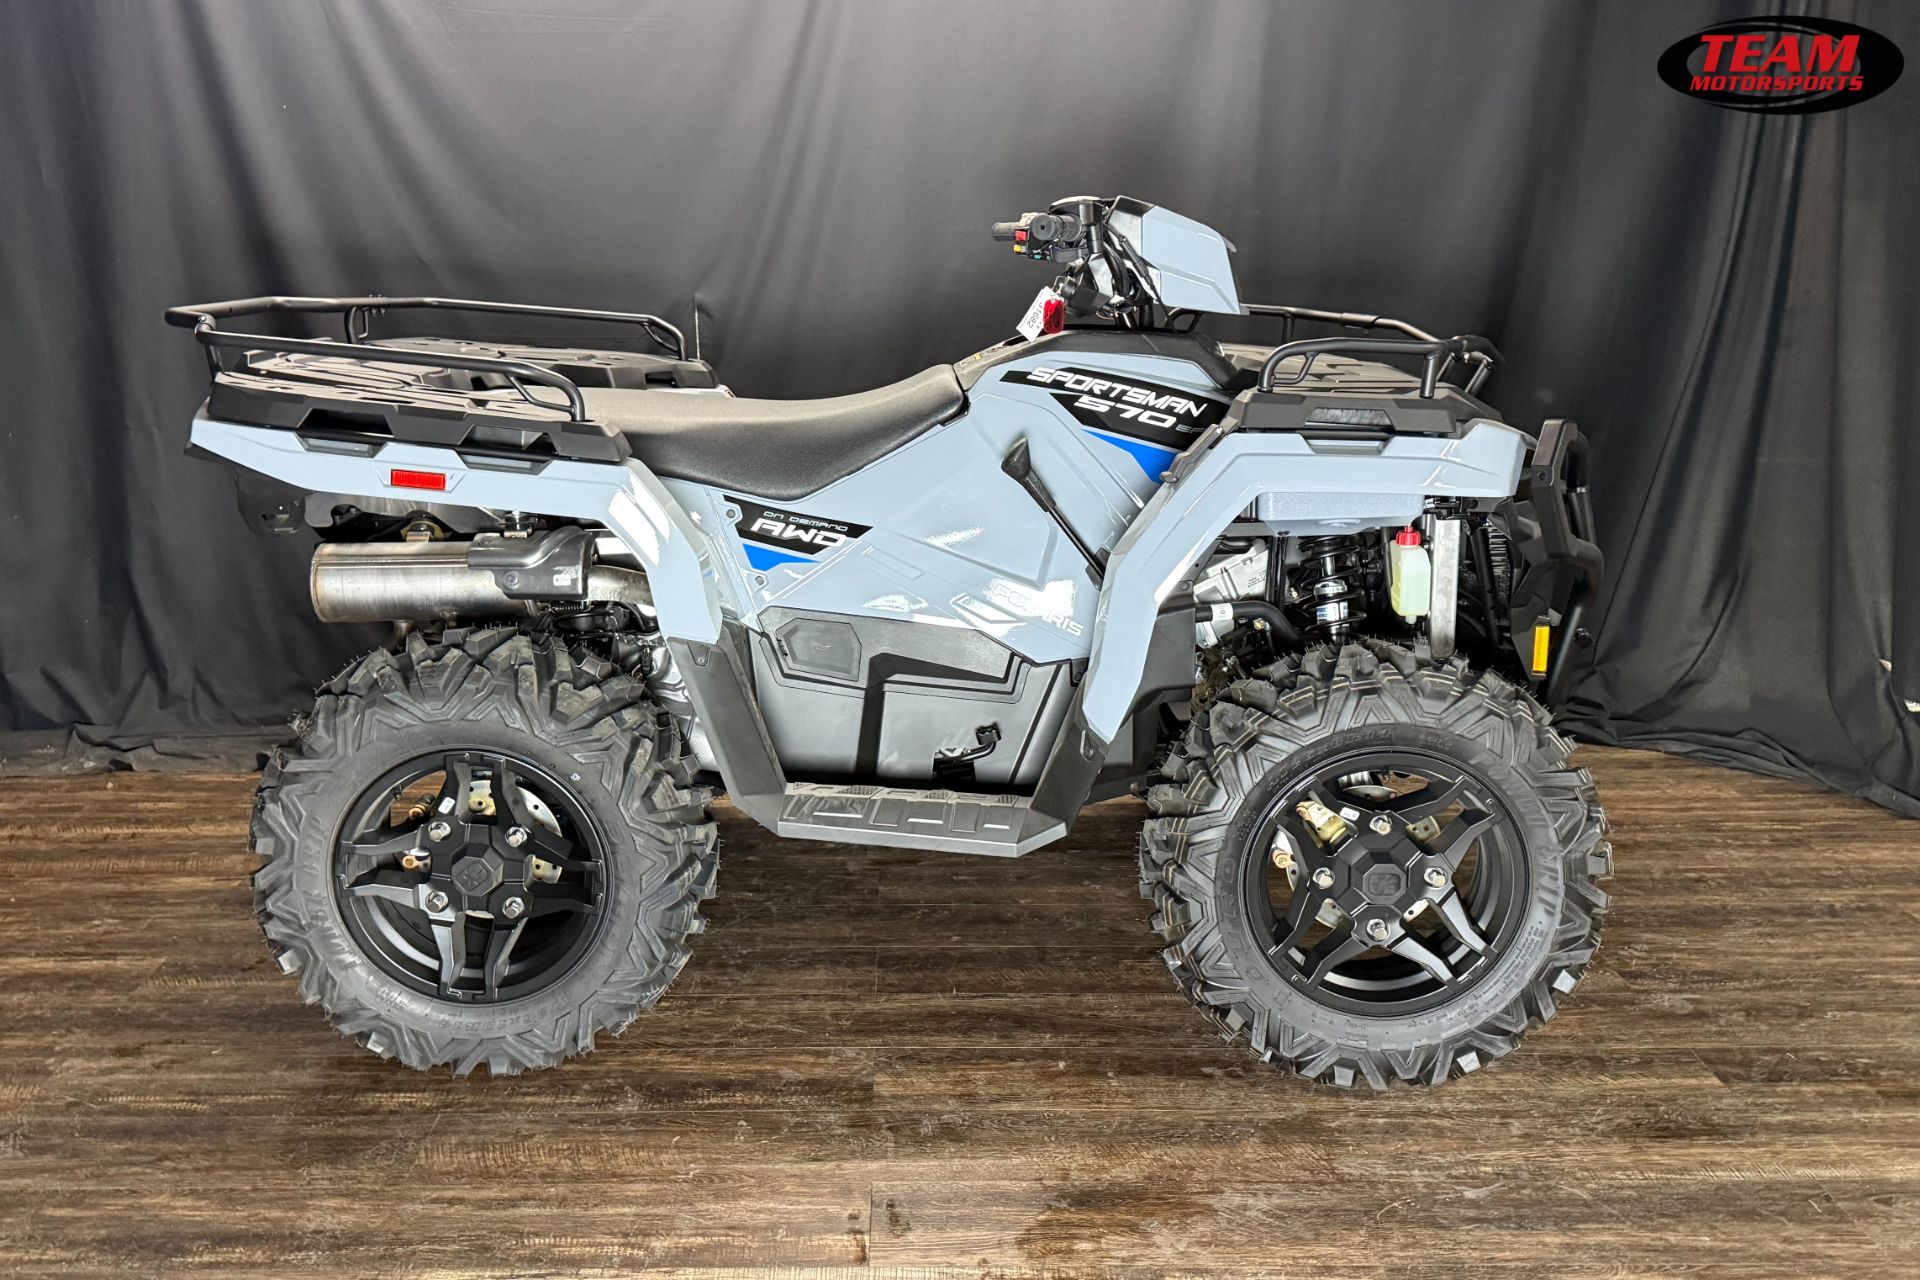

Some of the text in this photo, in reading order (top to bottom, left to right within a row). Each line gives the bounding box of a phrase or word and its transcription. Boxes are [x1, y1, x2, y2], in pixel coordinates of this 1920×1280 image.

[1026, 366, 1208, 418] SPORTSMAN
[1073, 395, 1177, 429] 570
[750, 517, 847, 547] AWD
[763, 510, 848, 532] ON DEMAND
[993, 581, 1084, 637] PORIS
